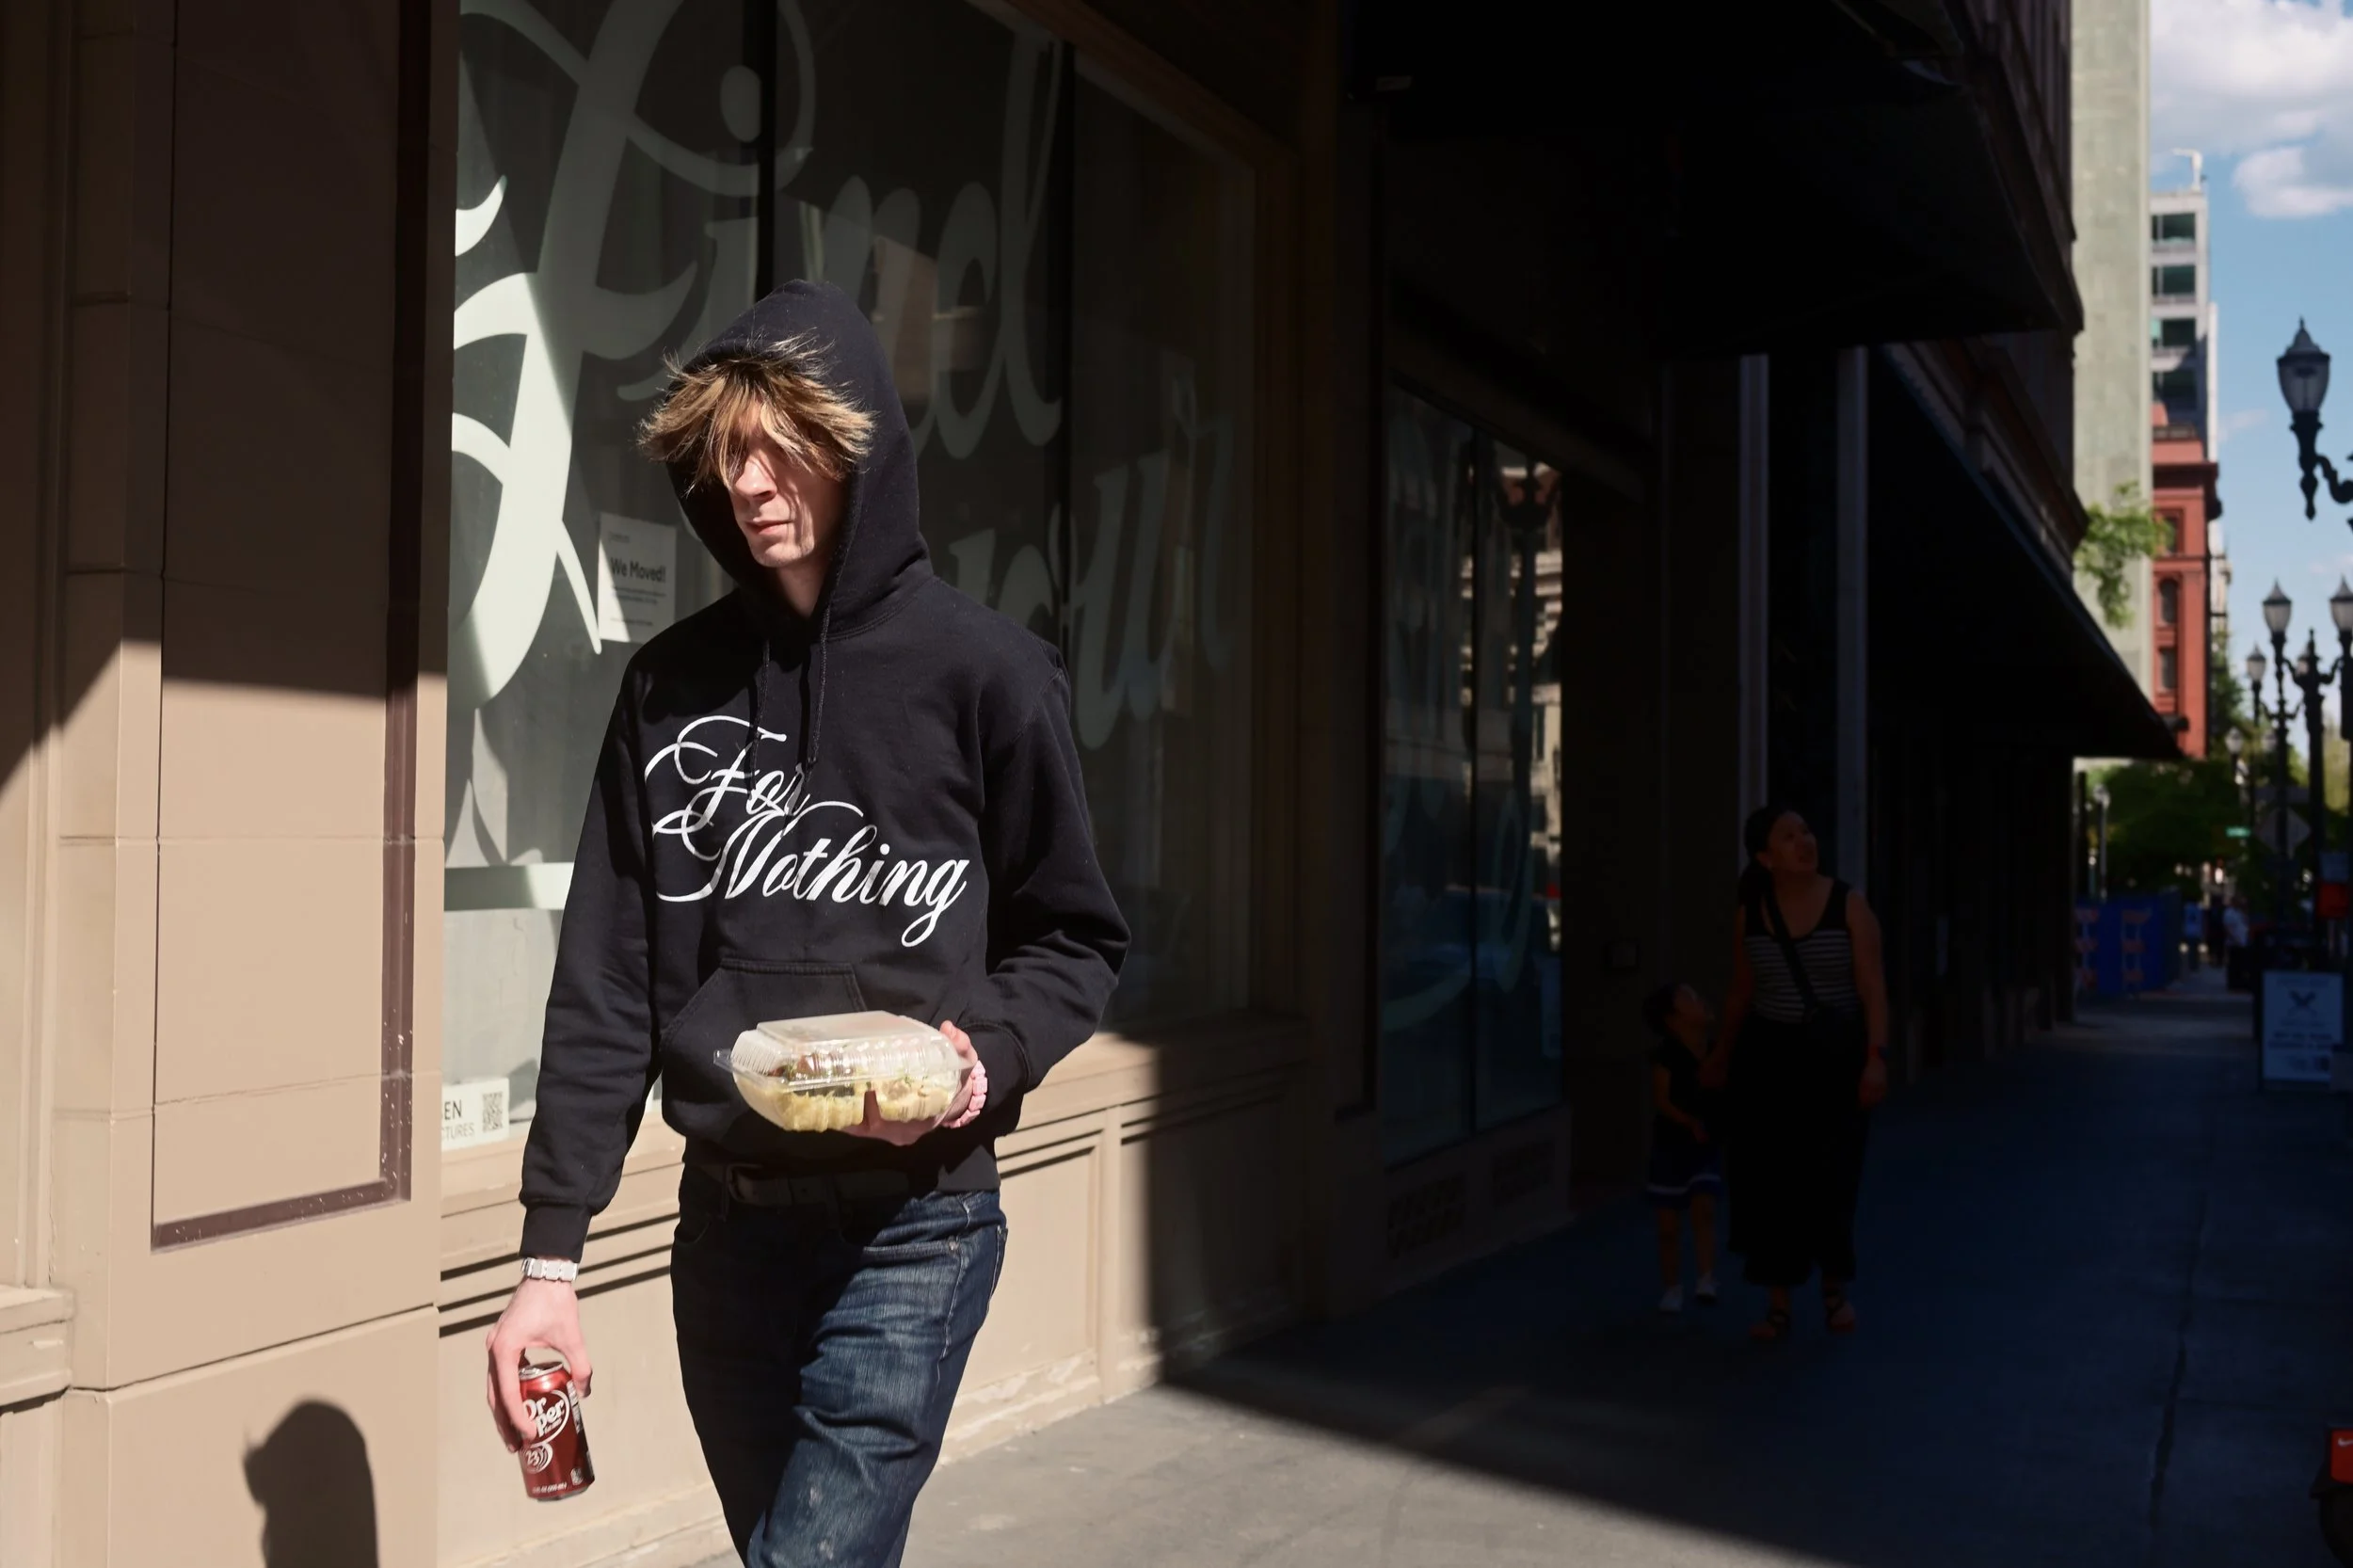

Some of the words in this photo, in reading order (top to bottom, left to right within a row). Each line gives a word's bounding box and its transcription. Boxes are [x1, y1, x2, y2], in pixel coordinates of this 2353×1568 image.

[610, 556, 627, 577] We
[630, 561, 666, 583] Moved!
[645, 715, 810, 840] For
[657, 787, 970, 948] Nothing
[441, 1122, 474, 1141] TURES
